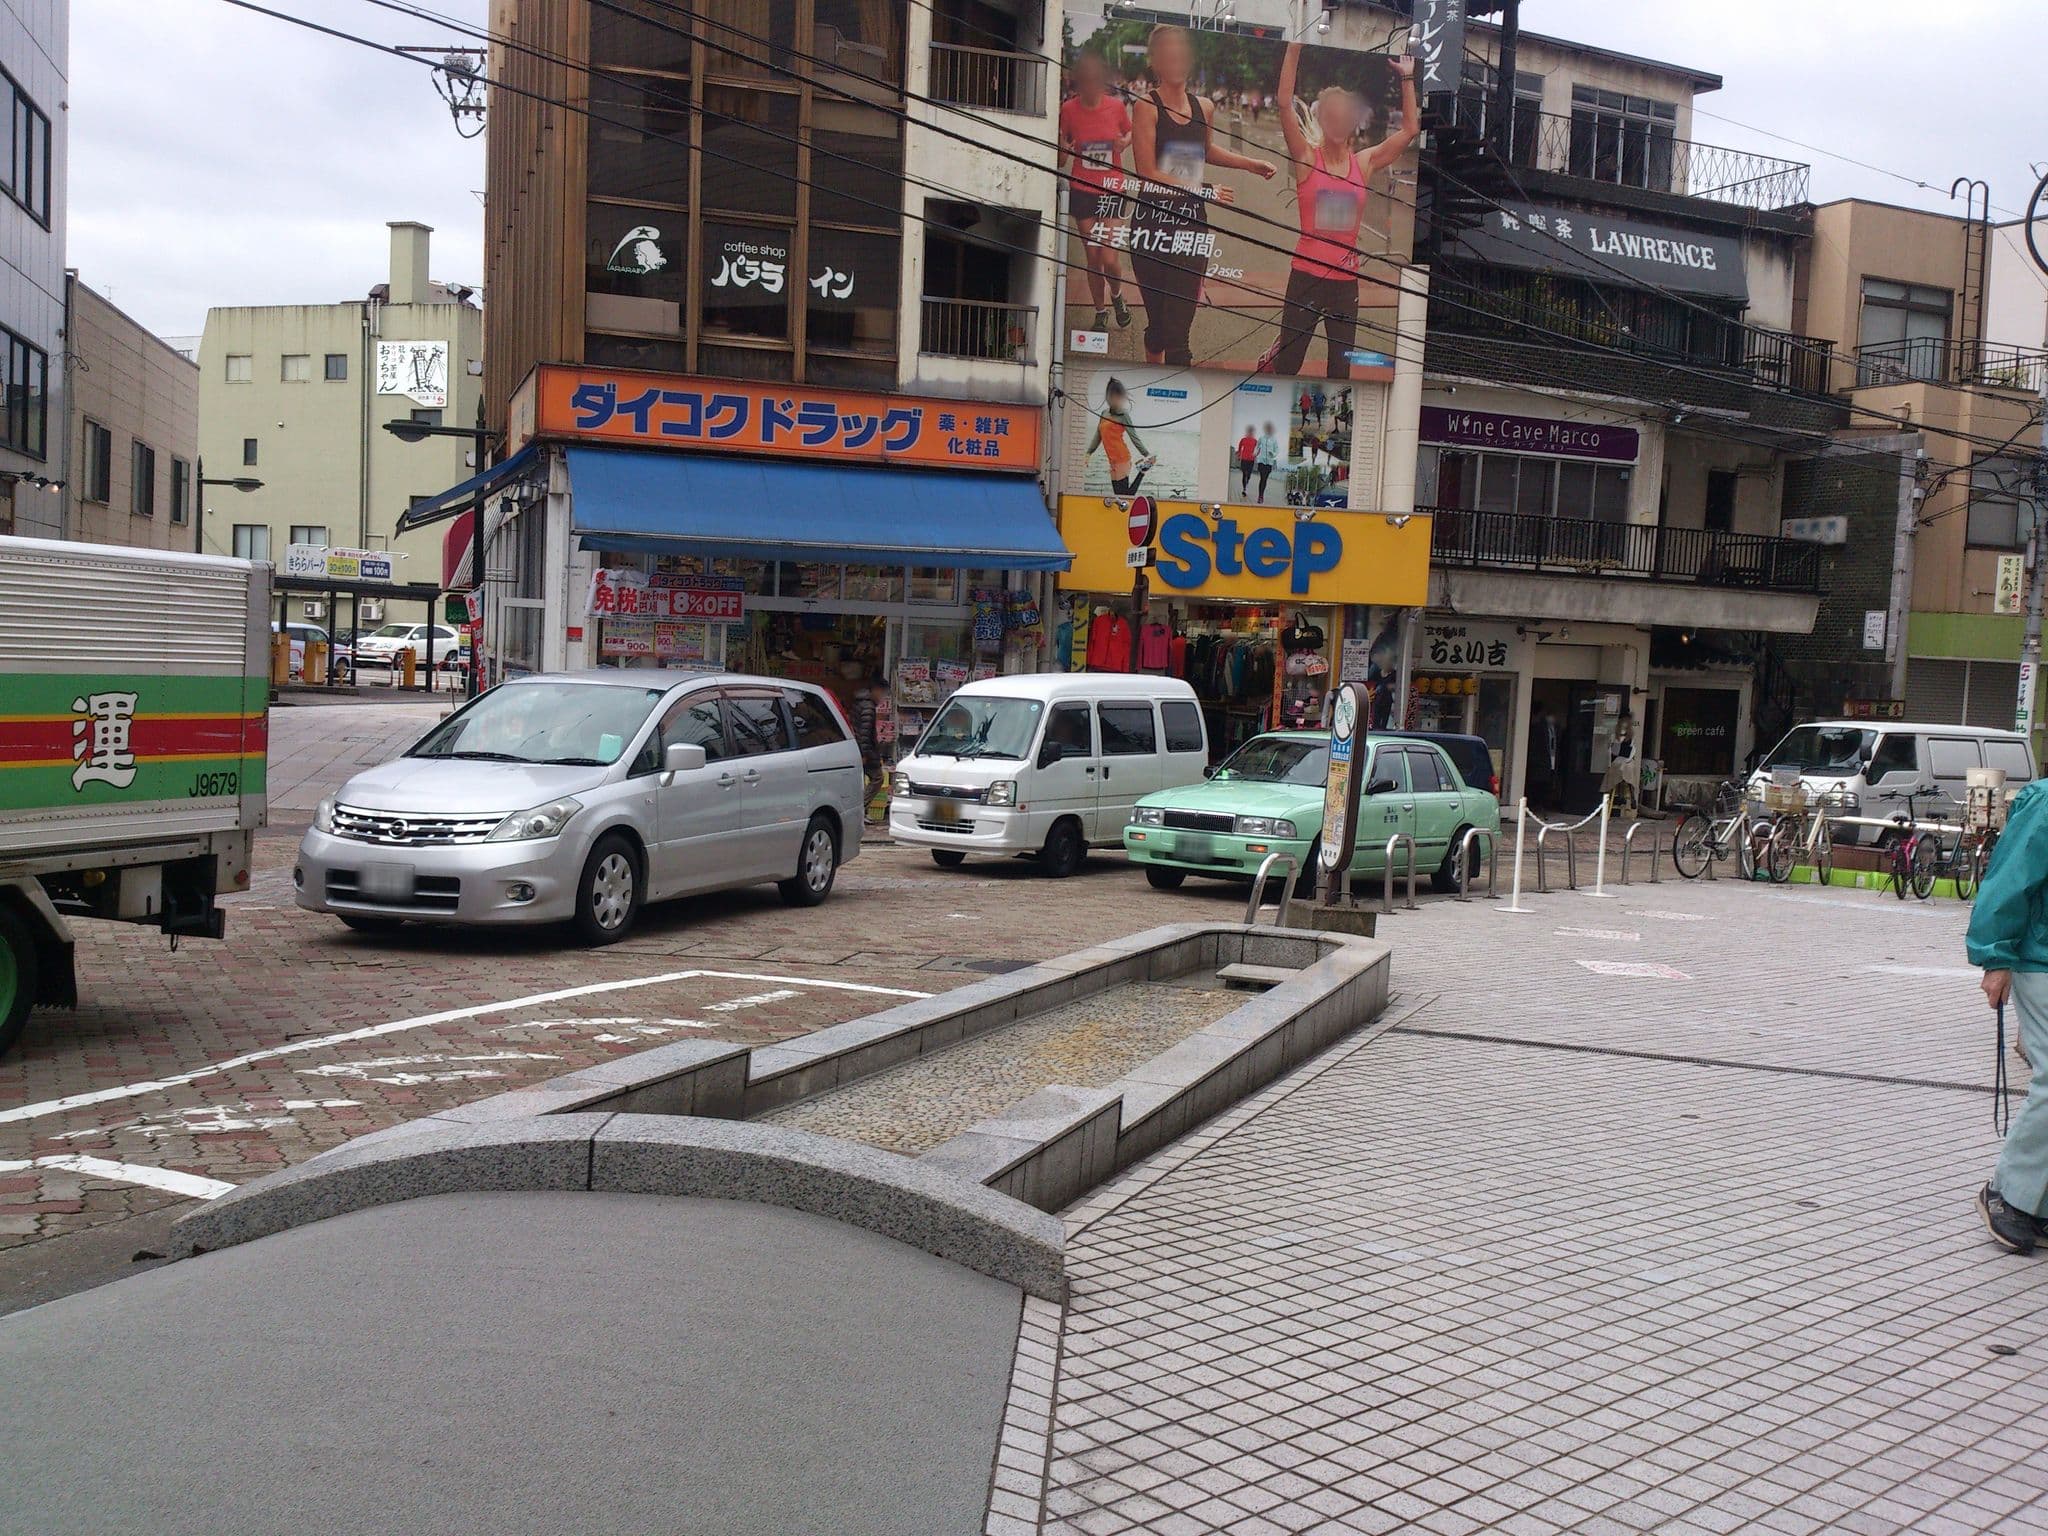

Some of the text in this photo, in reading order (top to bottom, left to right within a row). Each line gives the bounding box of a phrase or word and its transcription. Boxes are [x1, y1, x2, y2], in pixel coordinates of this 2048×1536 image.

[1102, 176, 1120, 190] WE
[1120, 179, 1143, 193] ARE
[723, 241, 786, 260] coffee shop
[1087, 221, 1223, 259] 生まれた瞬間。
[1588, 226, 1718, 272] LAWRENCE
[570, 382, 924, 452] ダイコクドラッグ
[947, 436, 1000, 457] 化粧品
[1500, 419, 1544, 442] Cave
[1549, 424, 1601, 448] Marco
[1155, 513, 1344, 595] Step
[594, 584, 639, 614] 免税
[672, 591, 739, 615] 8%OFF
[71, 690, 139, 793] 運
[1677, 726, 1703, 738] green
[188, 771, 238, 798] J9679
